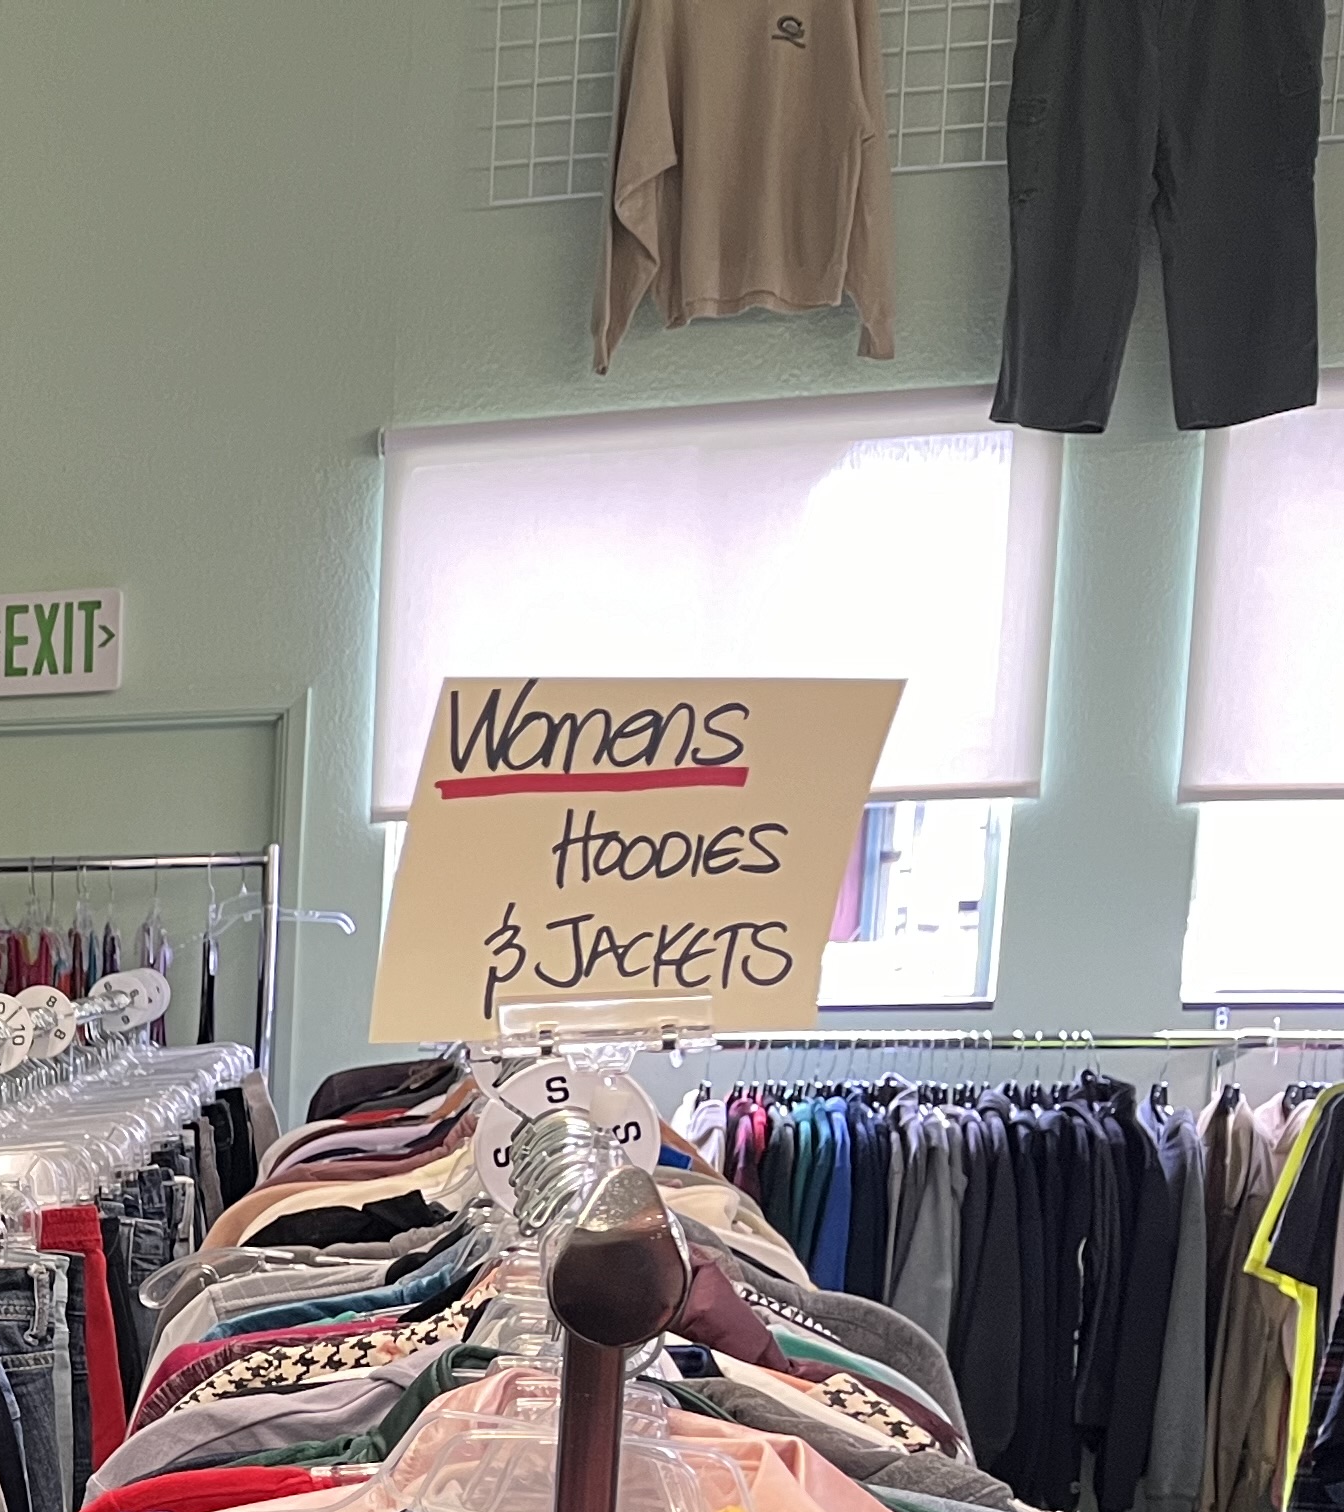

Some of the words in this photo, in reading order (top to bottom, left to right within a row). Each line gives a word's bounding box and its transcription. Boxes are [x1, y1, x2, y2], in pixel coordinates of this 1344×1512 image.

[4, 600, 102, 677] EXIT
[449, 677, 750, 775] Womens
[552, 808, 789, 889] HOODIES
[533, 913, 794, 989] JACKETS
[46, 995, 58, 1008] 8
[12, 1024, 26, 1046] 10
[54, 1028, 66, 1040] 8
[545, 1075, 570, 1104] S
[612, 1121, 642, 1145] S
